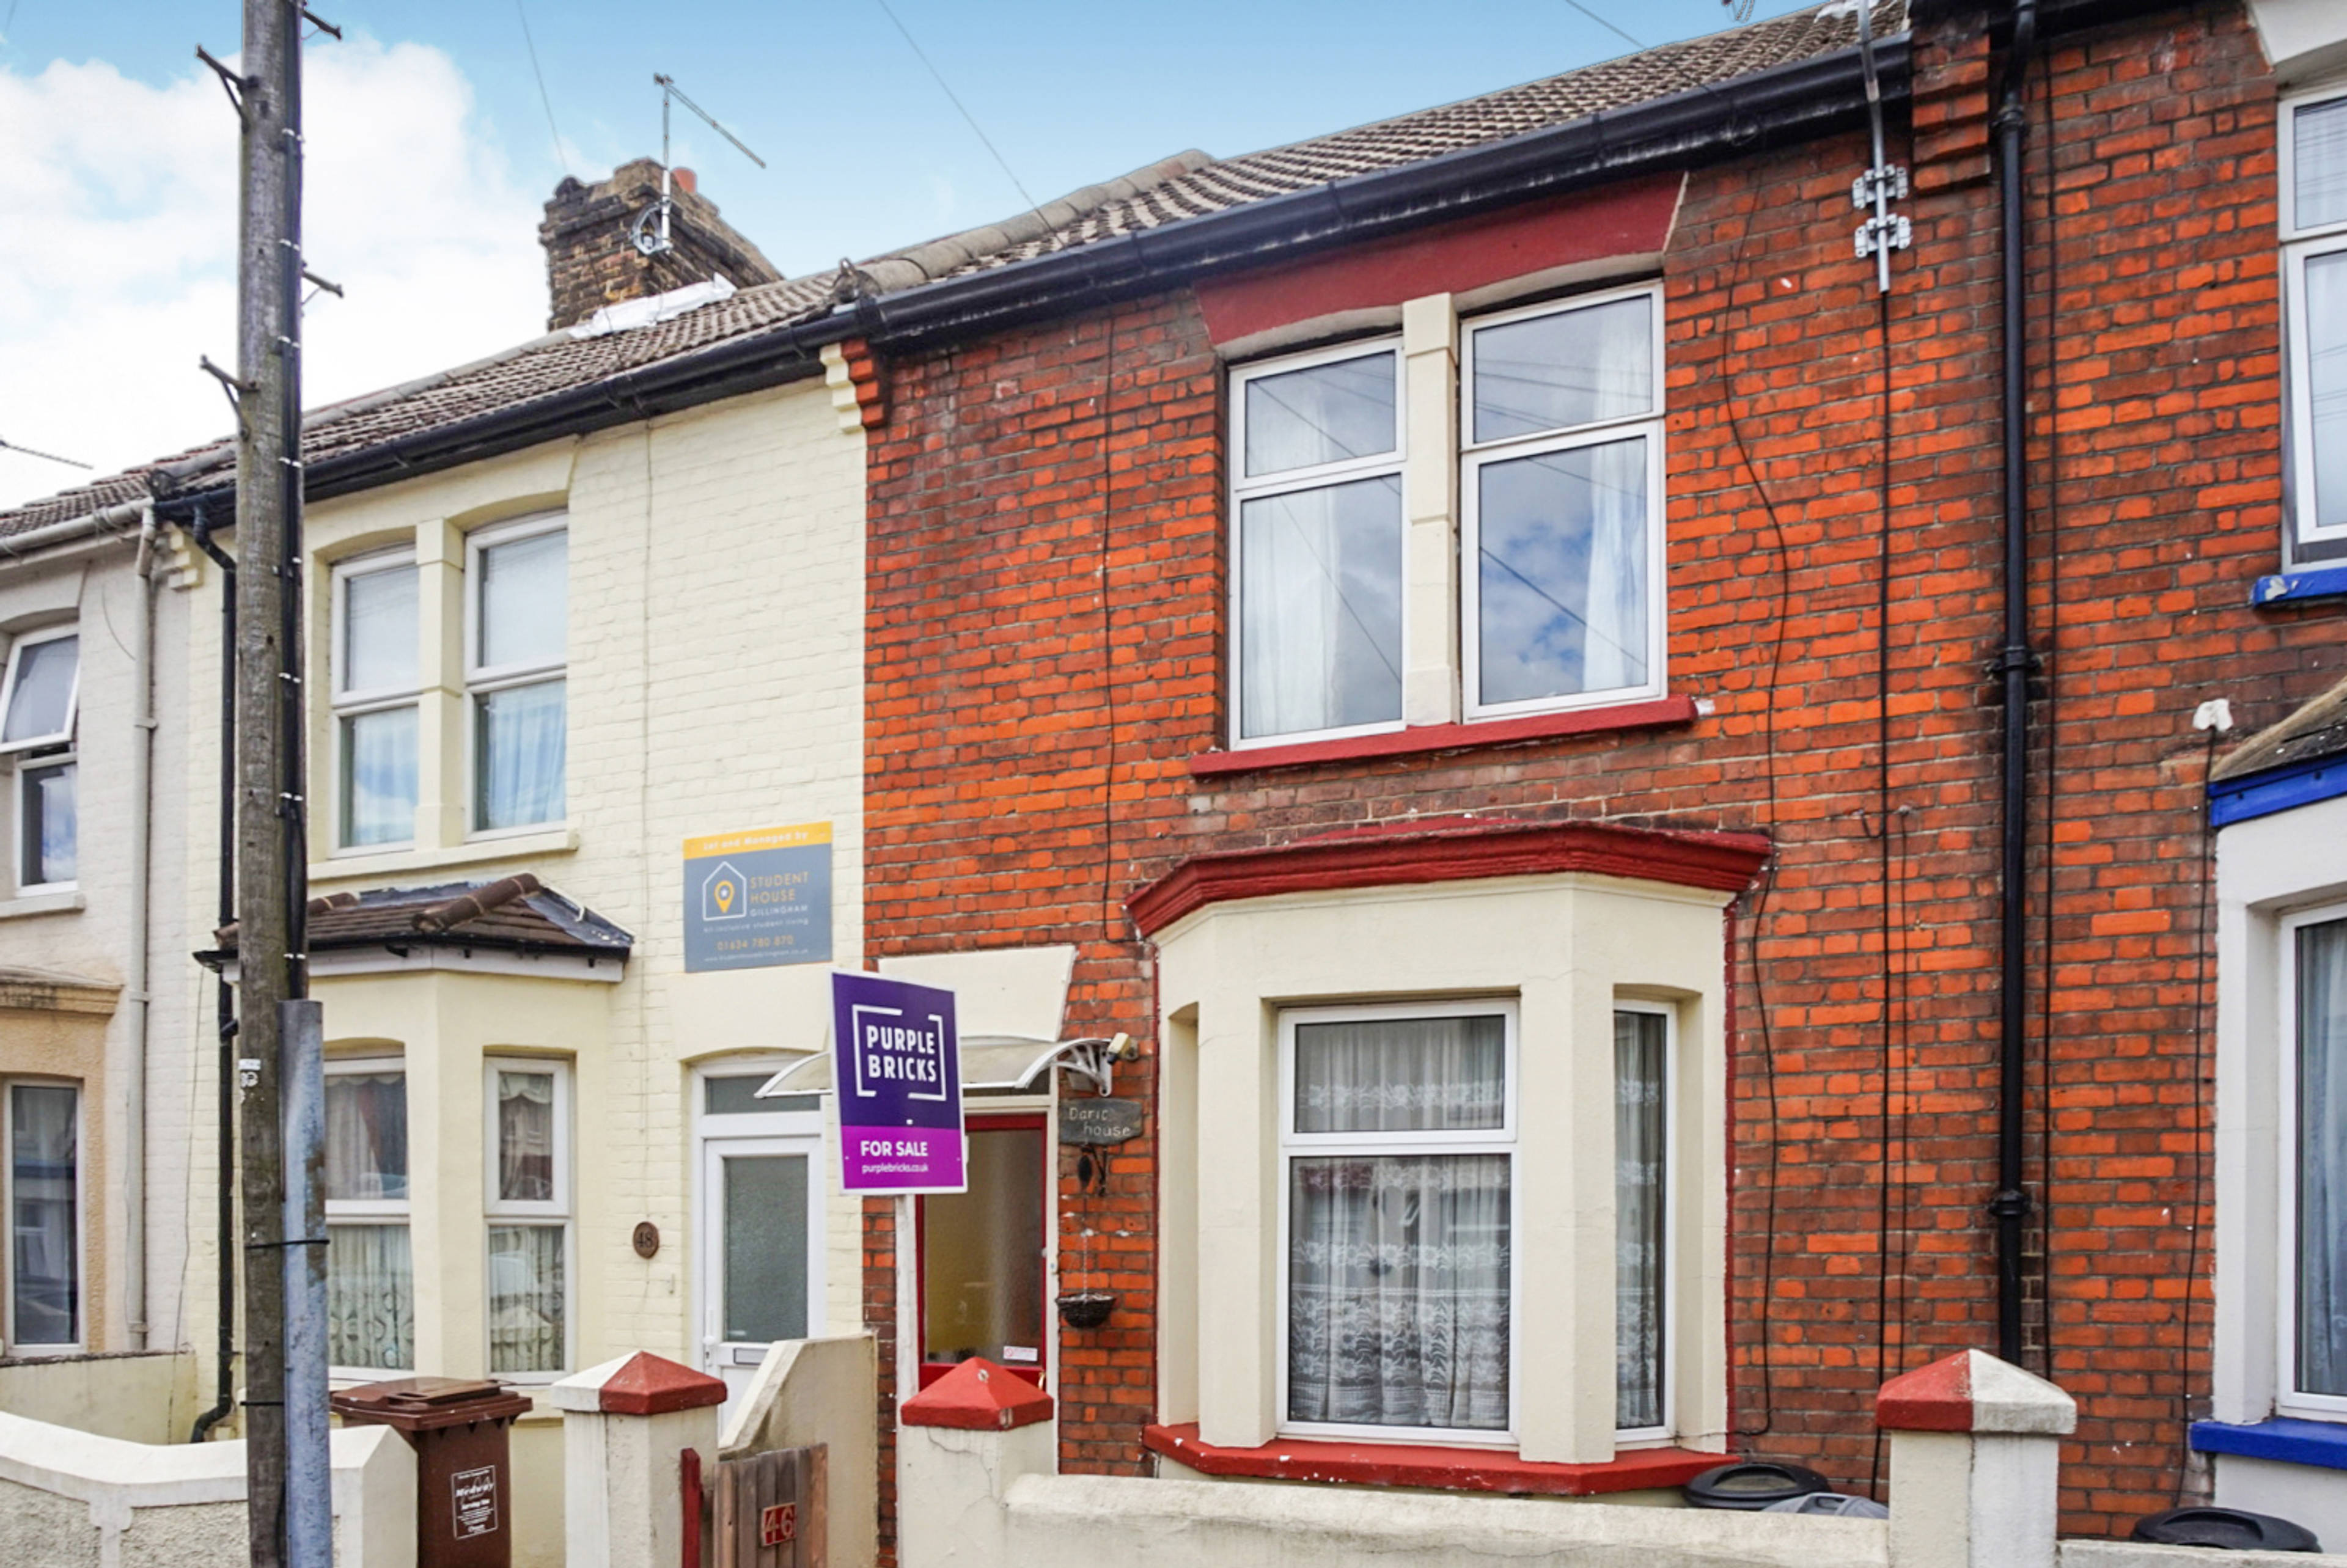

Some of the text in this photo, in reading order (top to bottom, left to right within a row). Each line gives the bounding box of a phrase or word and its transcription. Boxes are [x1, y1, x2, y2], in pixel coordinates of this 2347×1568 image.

[703, 832, 809, 850] Let and Managed by
[750, 871, 809, 888] STUDENT
[750, 888, 796, 904] HOUSE
[750, 905, 809, 917] GILLINGHAM
[717, 939, 748, 950] 01634
[752, 937, 771, 947] 780
[865, 1025, 936, 1054] PURPLE
[867, 1054, 937, 1082] BRICKS
[1084, 1122, 1131, 1137] house
[861, 1141, 928, 1157] FOR SALE
[862, 1162, 928, 1174] purplebricks.co.uk
[636, 1231, 653, 1248] 48
[764, 1506, 793, 1543] 46
